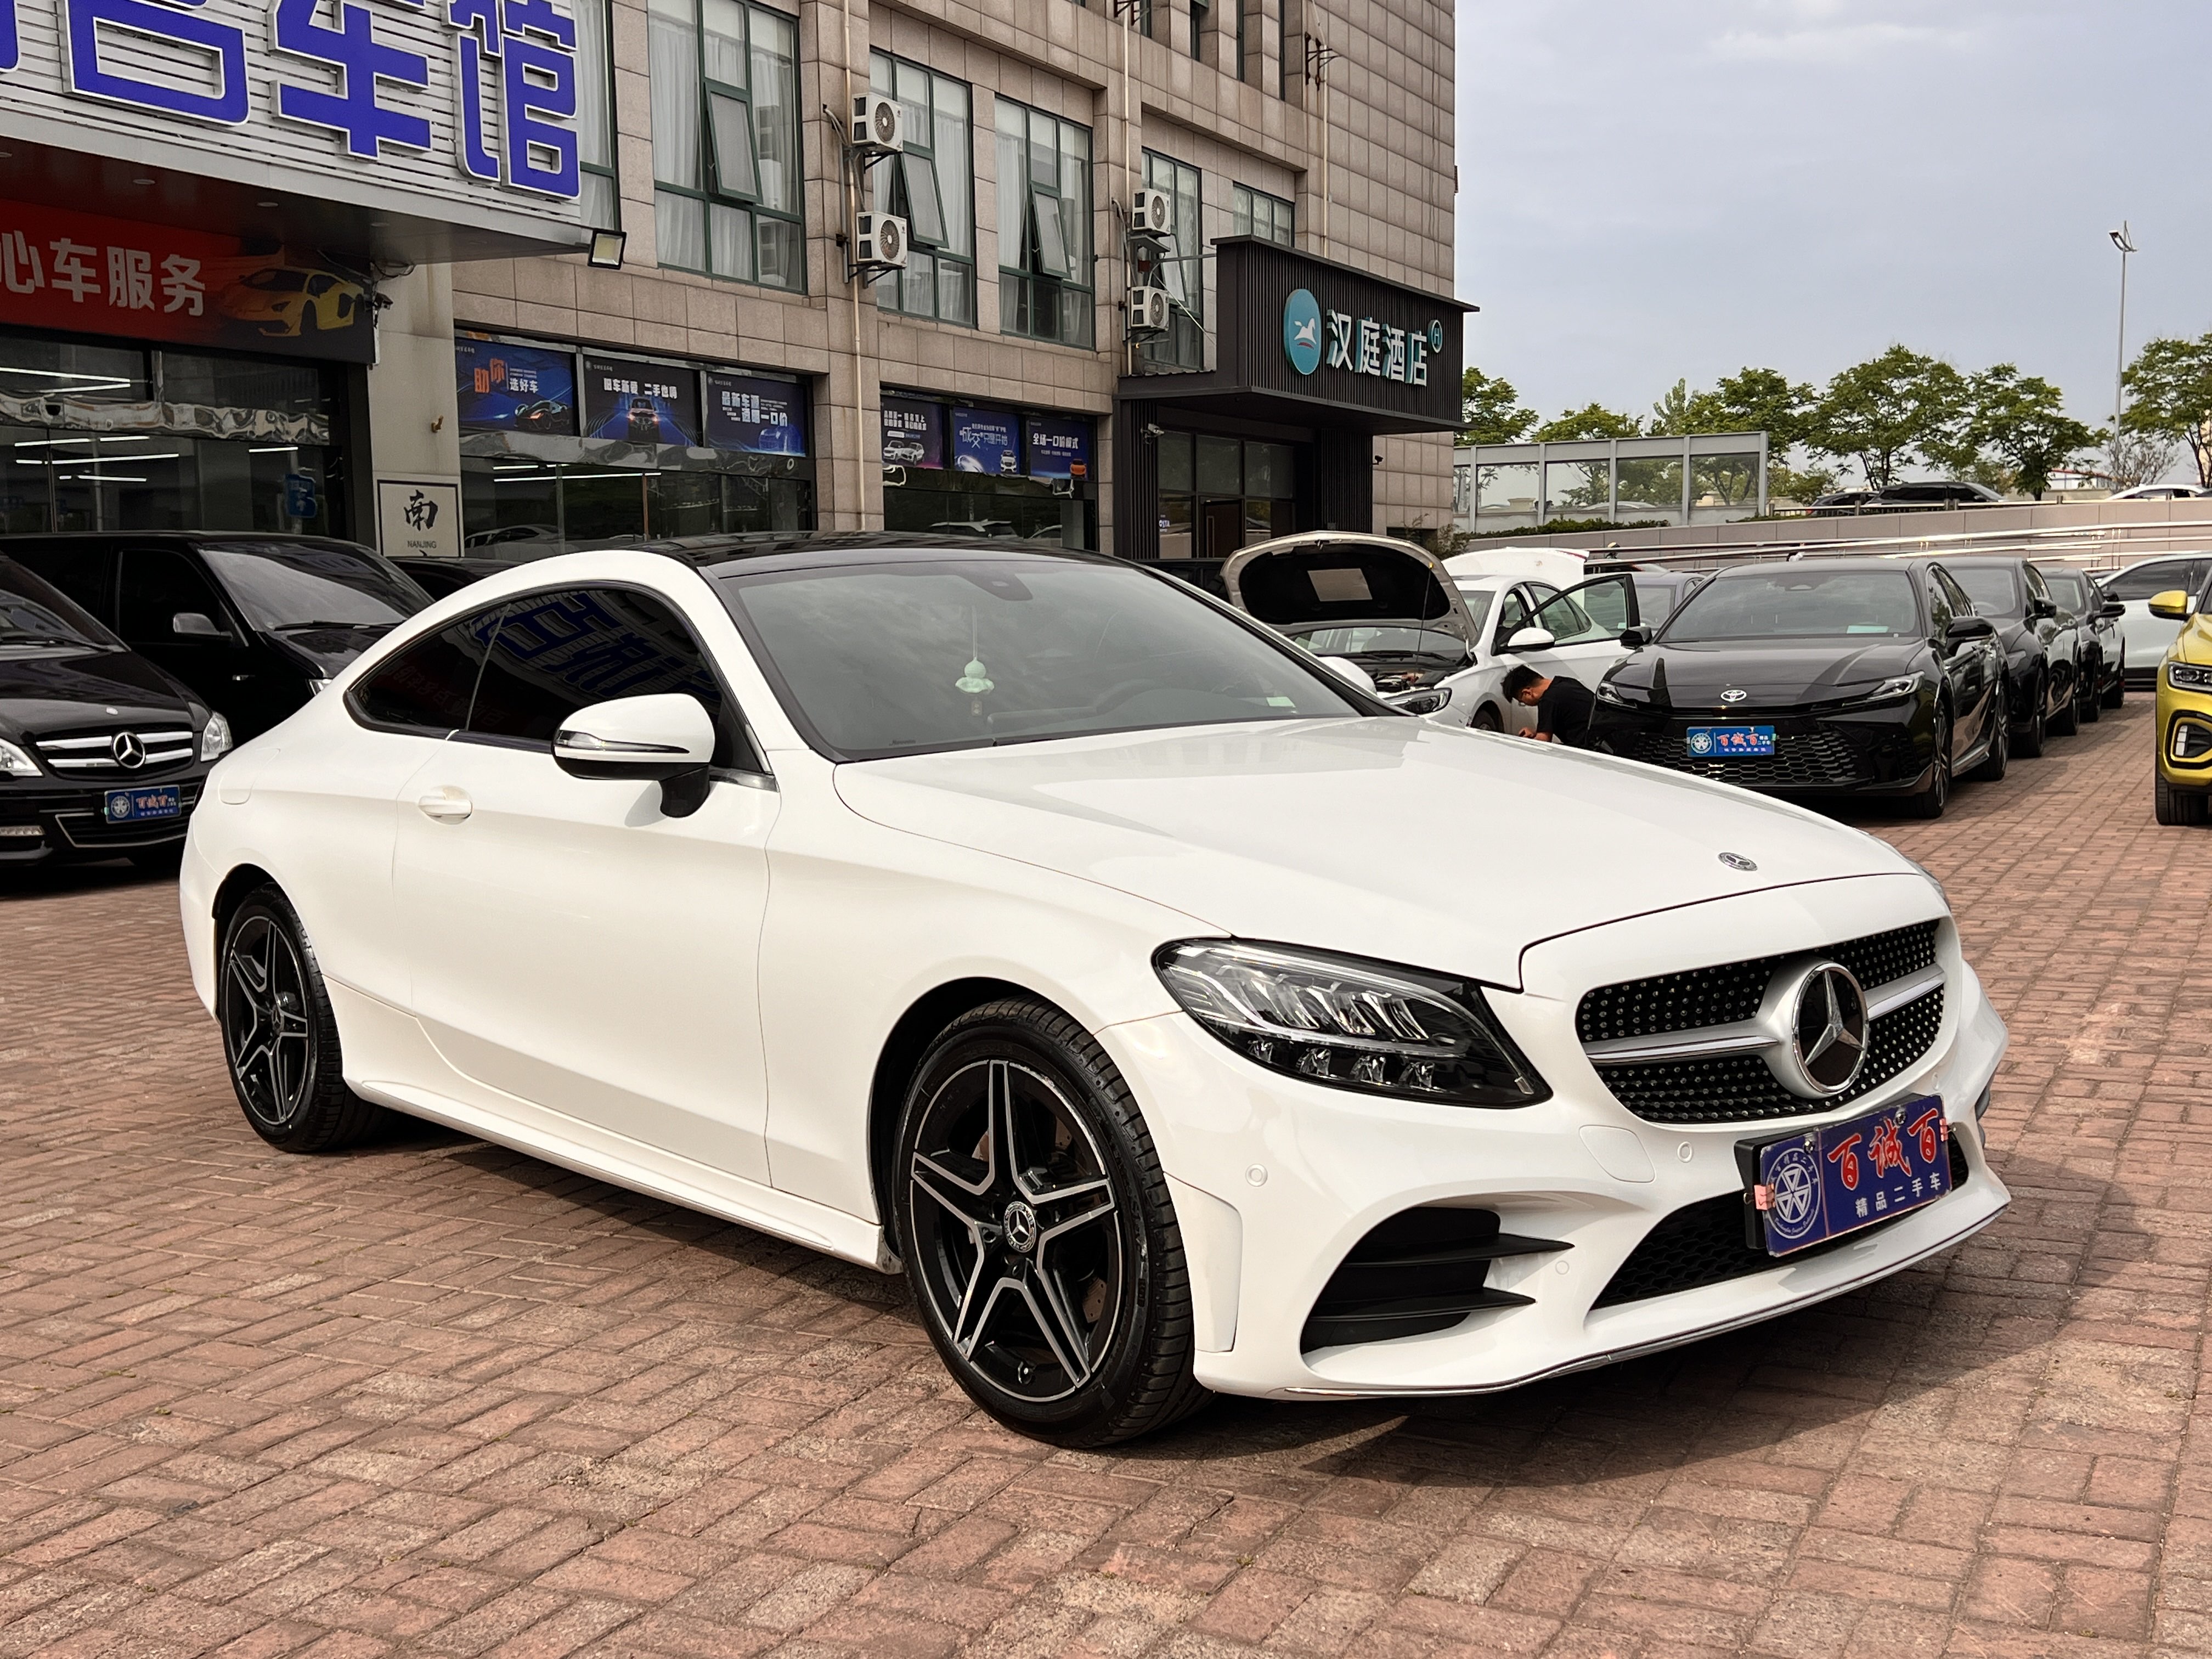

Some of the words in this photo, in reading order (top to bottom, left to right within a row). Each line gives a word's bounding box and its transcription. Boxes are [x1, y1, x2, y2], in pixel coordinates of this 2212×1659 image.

[0, 230, 205, 317] 心车服务
[1327, 309, 1427, 386] 汉庭酒店
[510, 377, 538, 394] 选好车
[404, 489, 438, 531] 南
[408, 540, 437, 549] NANJING
[1827, 1108, 1938, 1190] 百诚百
[1855, 1171, 1942, 1218] 精品二手车
